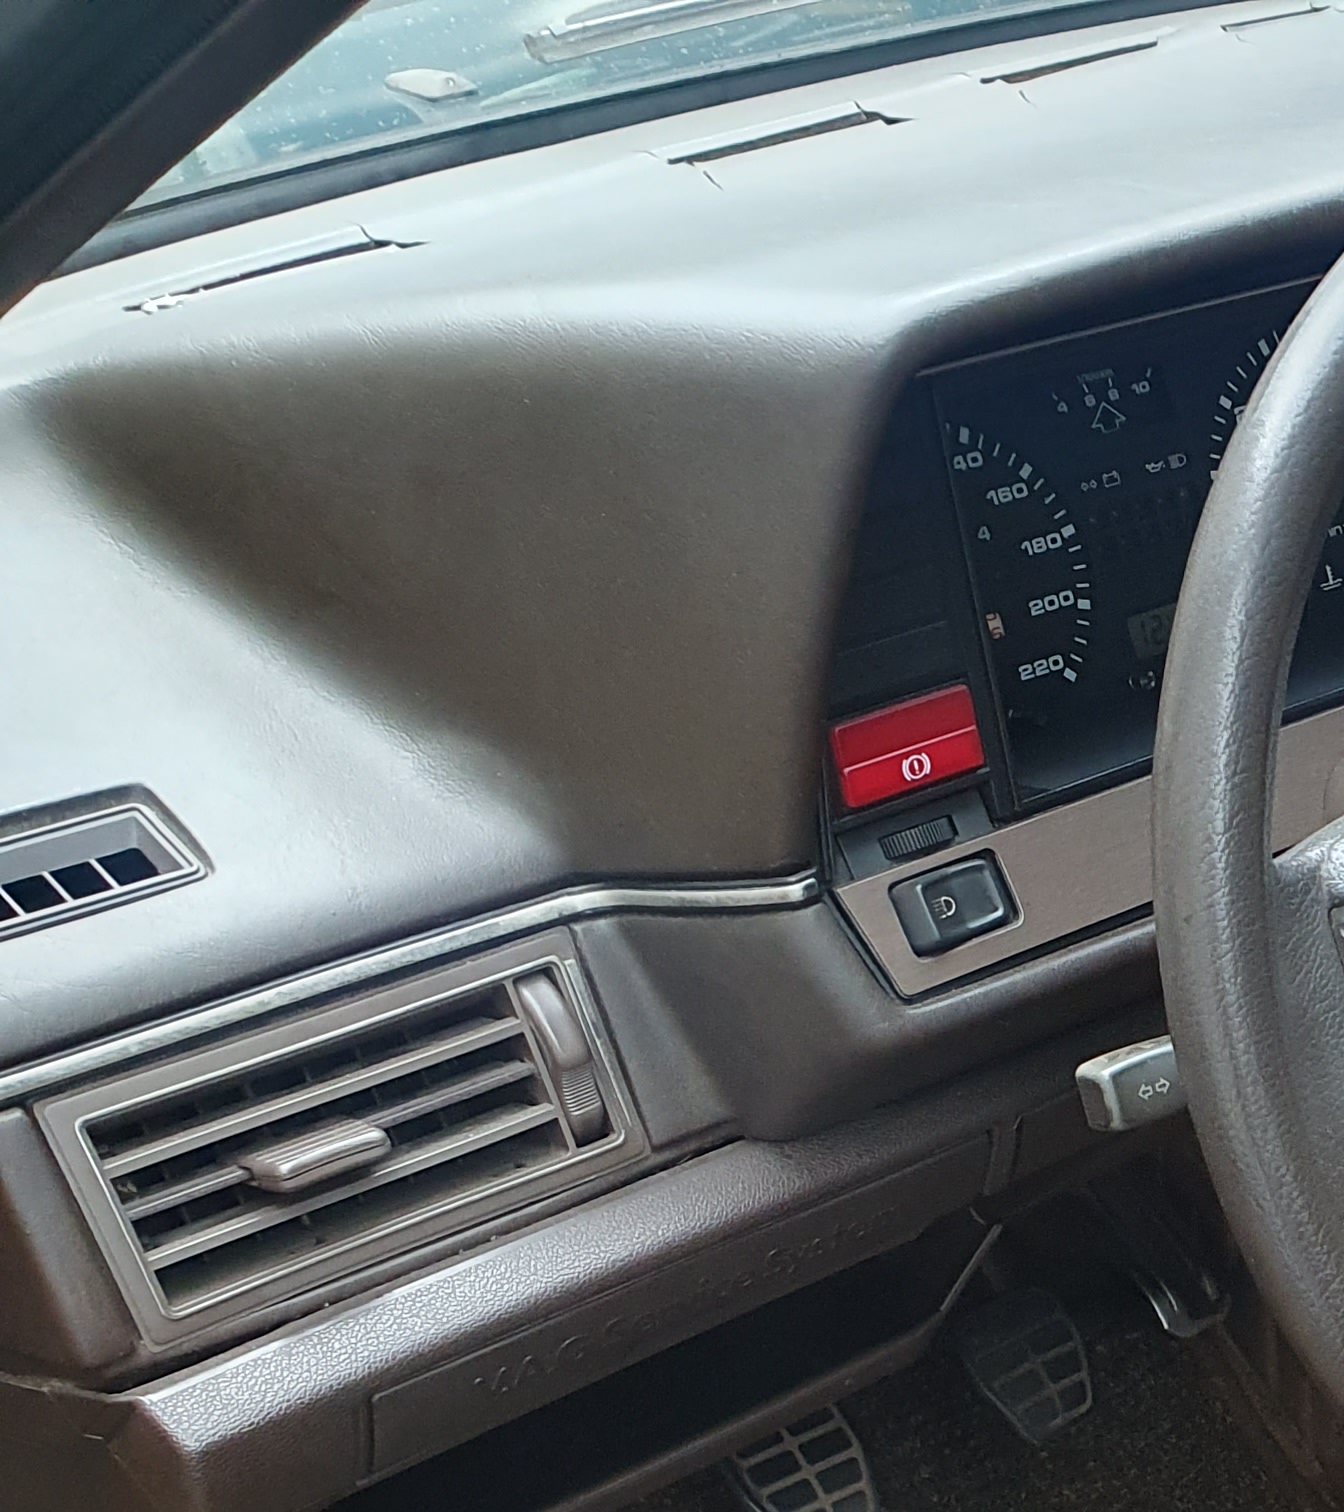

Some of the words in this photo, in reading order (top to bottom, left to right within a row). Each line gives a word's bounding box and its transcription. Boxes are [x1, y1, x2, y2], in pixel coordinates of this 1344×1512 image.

[1131, 381, 1150, 395] 10
[986, 483, 1029, 506] 160
[977, 525, 991, 541] 4
[1020, 532, 1063, 556] 180
[1028, 590, 1075, 617] 200
[1018, 654, 1065, 681] 220
